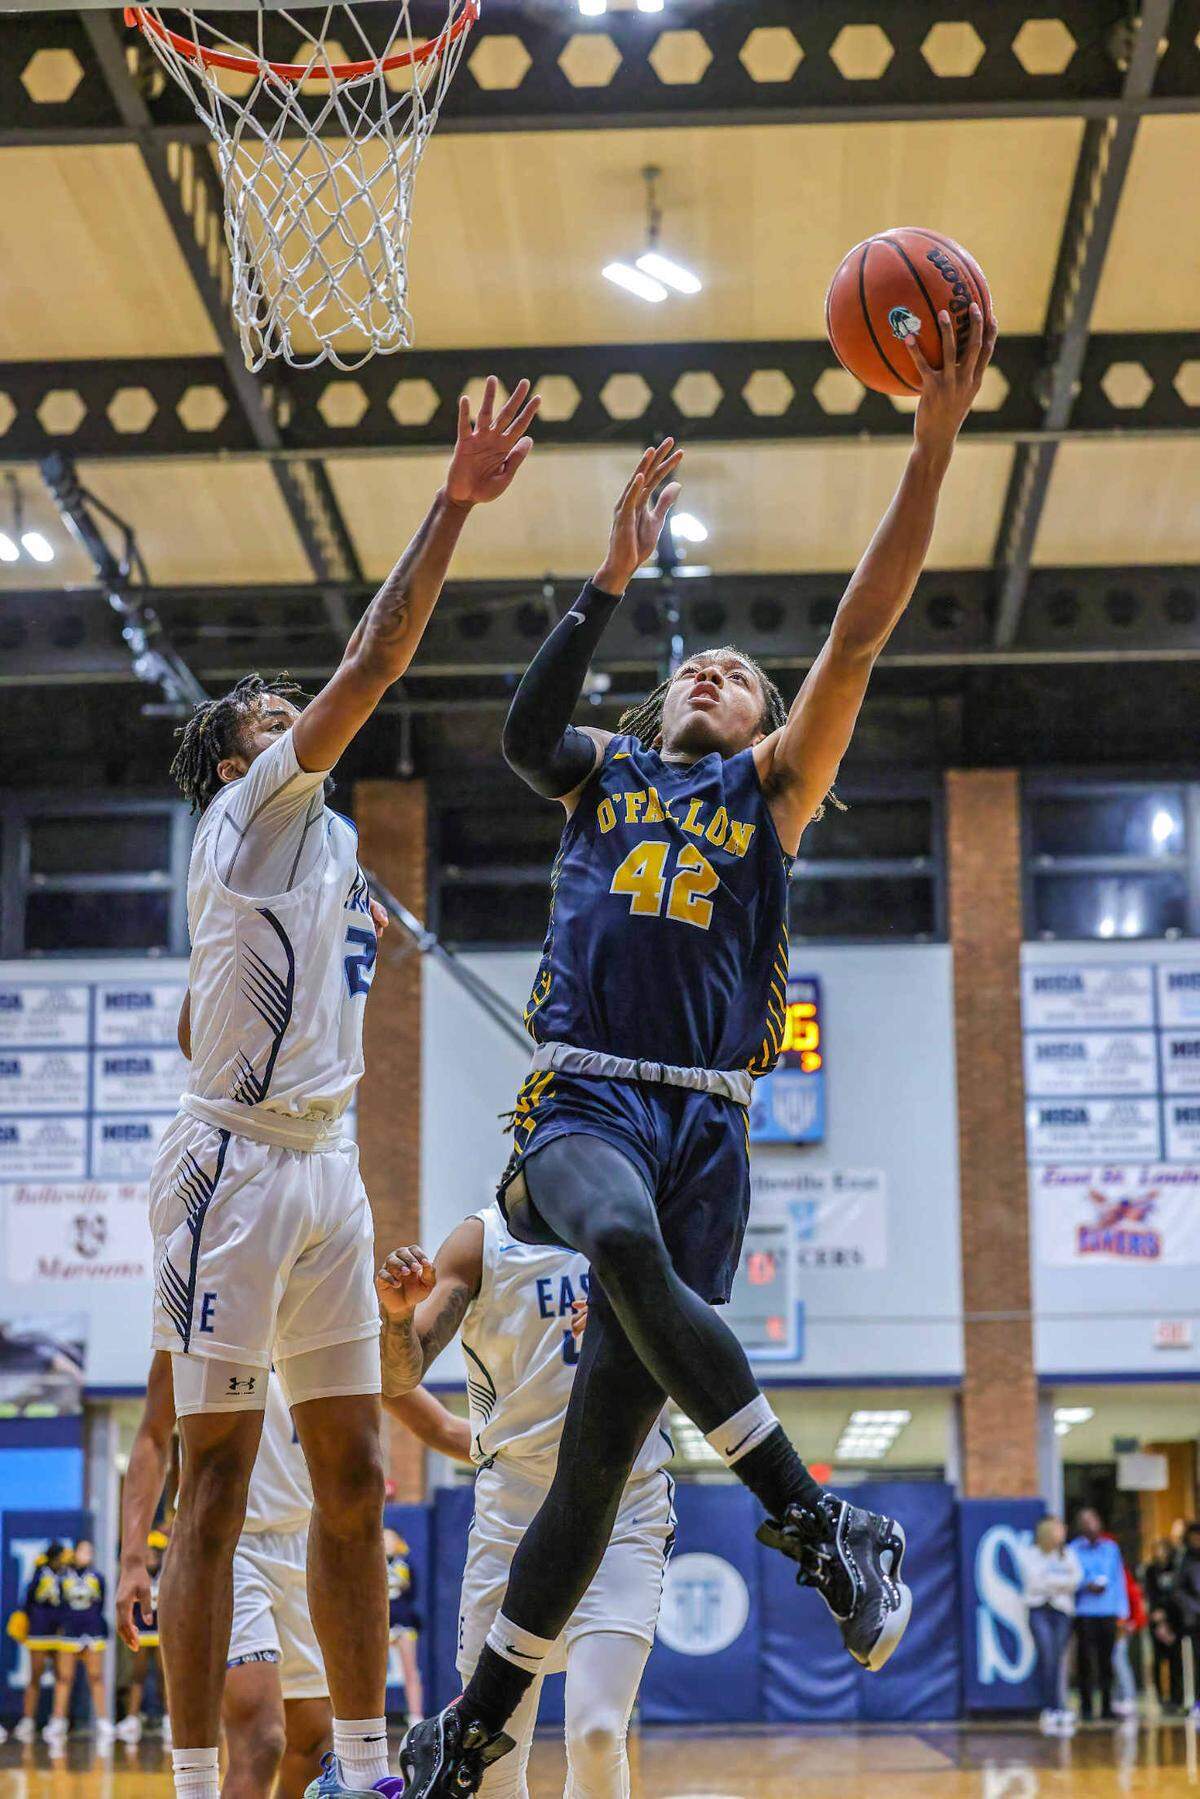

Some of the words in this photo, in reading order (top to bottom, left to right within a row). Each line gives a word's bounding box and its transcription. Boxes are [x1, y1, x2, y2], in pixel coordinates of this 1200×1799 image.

[596, 787, 756, 858] O'FALLON
[609, 840, 721, 931] 42
[200, 1292, 218, 1333] E
[535, 1274, 590, 1319] EAS
